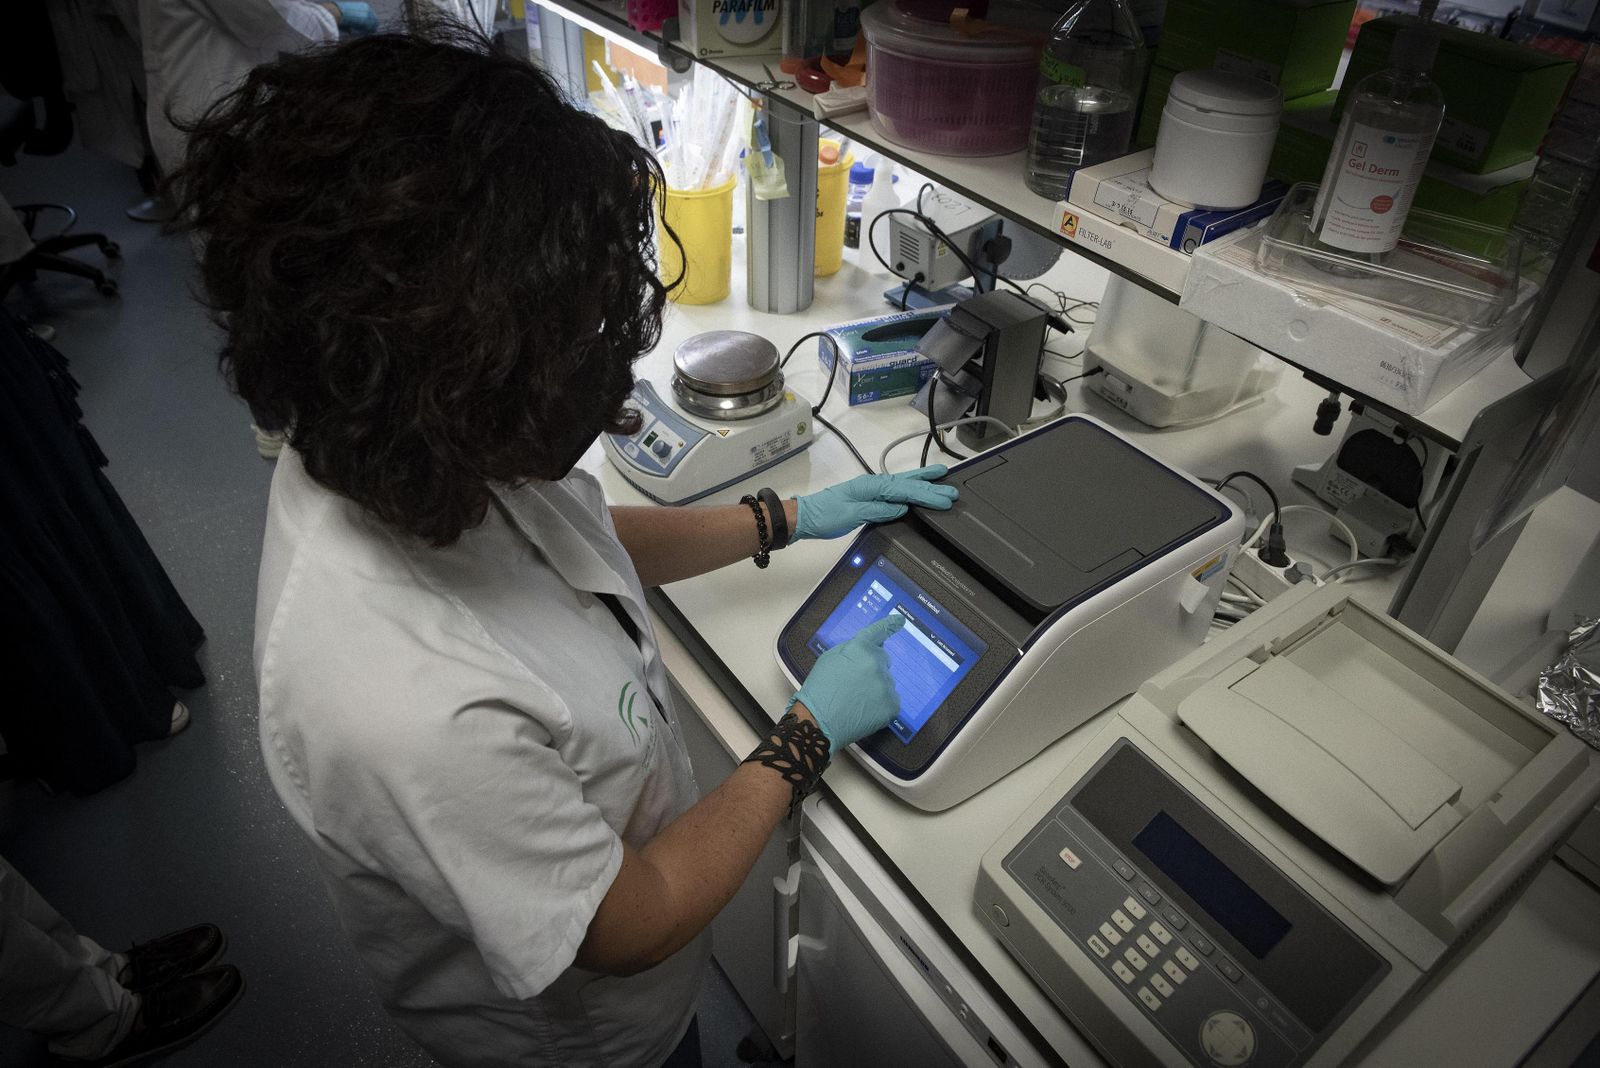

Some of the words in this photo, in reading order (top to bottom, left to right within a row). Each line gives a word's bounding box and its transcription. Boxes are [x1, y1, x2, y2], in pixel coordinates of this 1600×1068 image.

[712, 0, 774, 13] PARAFILM
[1348, 157, 1367, 172] Gel
[1368, 163, 1400, 178] Derm
[1078, 226, 1113, 250] FILTER-LAB
